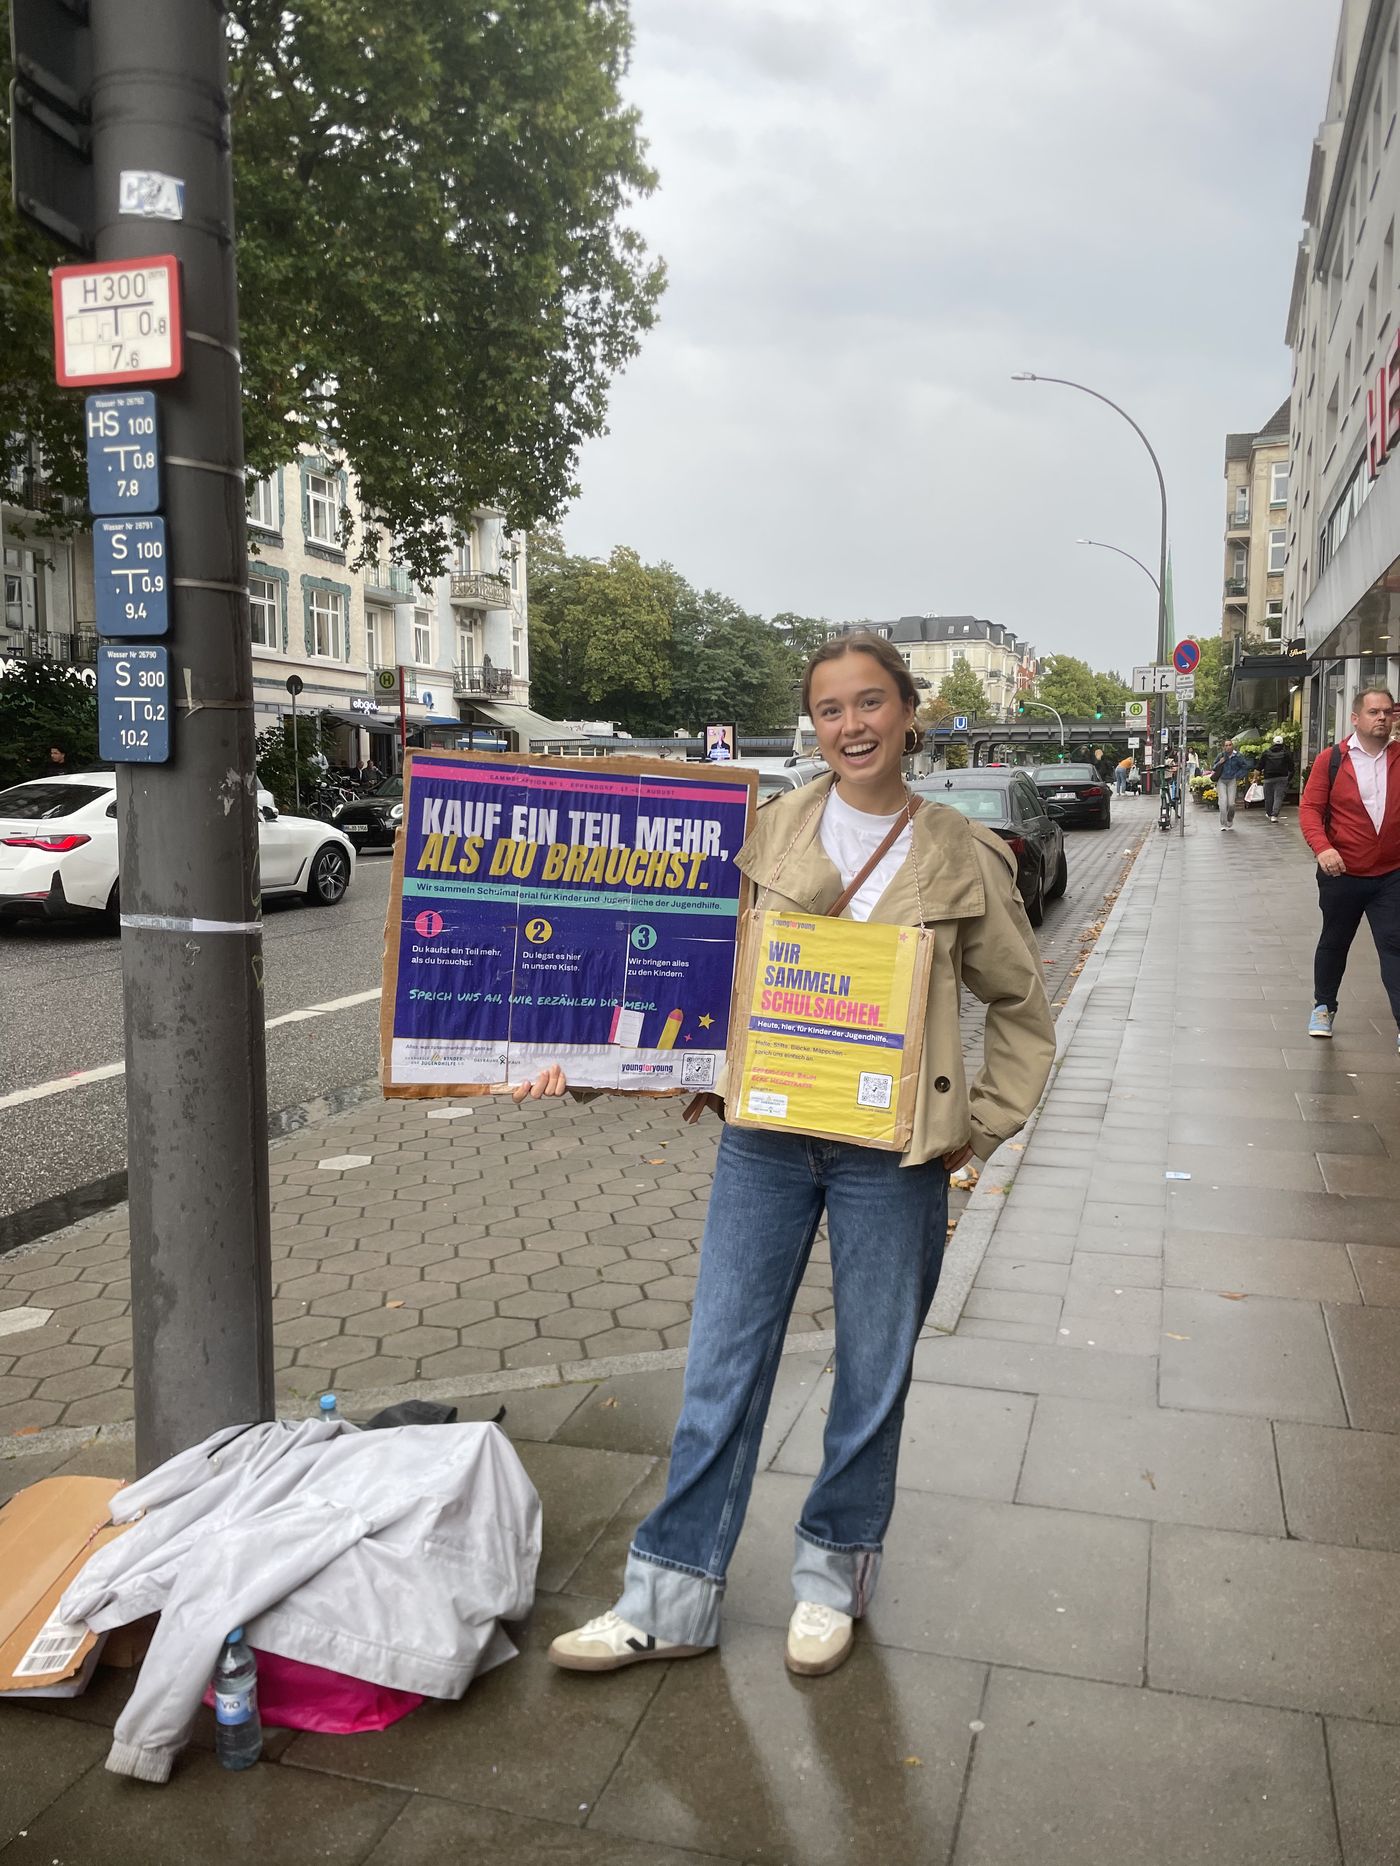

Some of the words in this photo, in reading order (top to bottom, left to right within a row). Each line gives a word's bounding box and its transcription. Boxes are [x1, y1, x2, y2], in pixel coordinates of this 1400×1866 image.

[112, 344, 139, 370] 7.6
[88, 410, 120, 438] HS
[128, 417, 154, 435] 100
[117, 480, 139, 497] 7,8
[111, 533, 128, 559] S
[137, 542, 162, 559] 100
[142, 576, 164, 593] 0,9
[125, 602, 147, 620] 9,4
[107, 651, 128, 659] Wasser
[115, 661, 131, 687] S
[138, 671, 165, 687] 300
[144, 705, 165, 721] 0,2
[120, 729, 149, 746] 10,2
[422, 797, 502, 841] KAUF
[511, 805, 558, 846] EIN
[568, 810, 626, 851] TEIL
[635, 816, 729, 862] MEHR,
[417, 833, 485, 875] ALS
[489, 837, 538, 879] DU
[541, 843, 709, 890] BRAUCHST.
[417, 883, 432, 891] Wir
[434, 883, 475, 894] sammeln
[553, 892, 582, 902] Kinder
[583, 895, 600, 903] und
[656, 899, 669, 907] der
[671, 899, 722, 910] Jugendhilfe.
[532, 921, 545, 942] 2
[638, 927, 650, 948] 3
[412, 945, 424, 953] Du
[425, 946, 450, 954] kaufst
[535, 952, 554, 961] legst
[566, 953, 581, 961] hier
[769, 940, 801, 965] WIR
[437, 958, 474, 966] brauchst.
[522, 962, 529, 970] in
[559, 963, 580, 972] Kiste.
[642, 958, 670, 967] bringen
[654, 970, 685, 978] Kindern.
[764, 965, 851, 997] SAMMELN
[409, 988, 452, 1001] SPRICH
[457, 993, 482, 1002] UNS
[508, 994, 533, 1005] WIR
[537, 993, 596, 1007] ERZÄHLEN
[600, 998, 619, 1007] DIR
[761, 990, 885, 1028] SCHULSACHEN.
[757, 1020, 780, 1030] Heute,
[781, 1023, 796, 1033] hier,
[797, 1025, 807, 1033] für
[808, 1027, 831, 1036] Kinder
[844, 1031, 889, 1043] Jugendhilfe.
